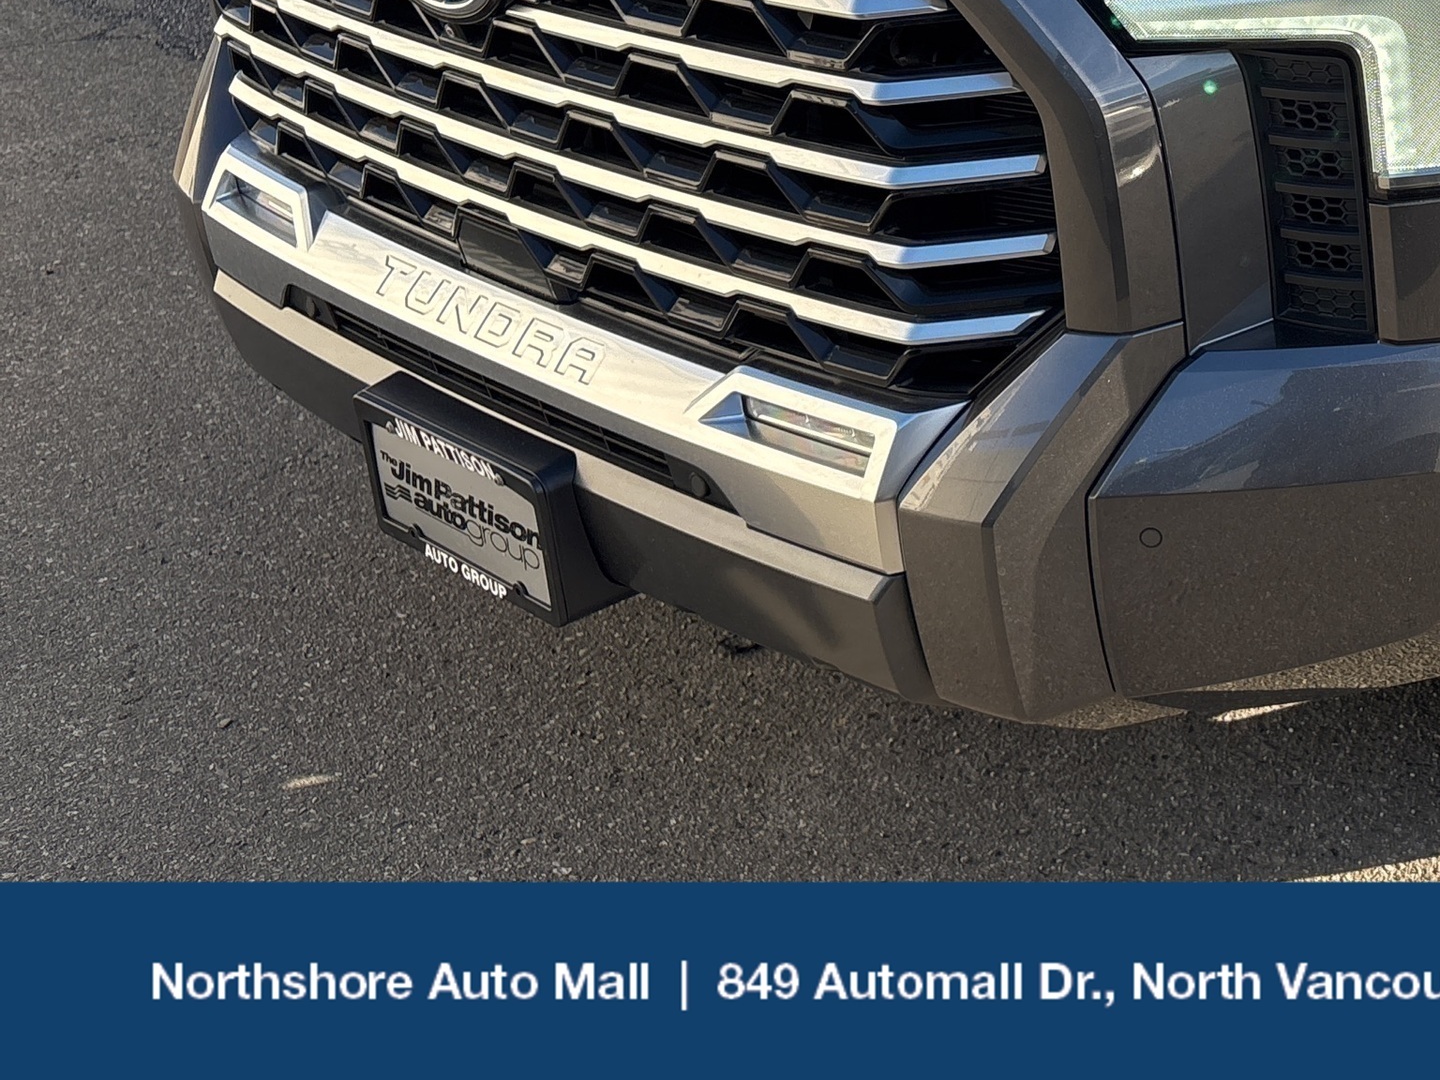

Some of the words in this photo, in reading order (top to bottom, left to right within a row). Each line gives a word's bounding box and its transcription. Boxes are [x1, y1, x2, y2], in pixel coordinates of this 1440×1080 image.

[376, 254, 606, 386] TUNDRA
[379, 449, 398, 468] The
[394, 418, 422, 447] JIM
[420, 431, 497, 481] PATTISON
[425, 543, 459, 573] AUTO
[460, 563, 508, 599] GROUP
